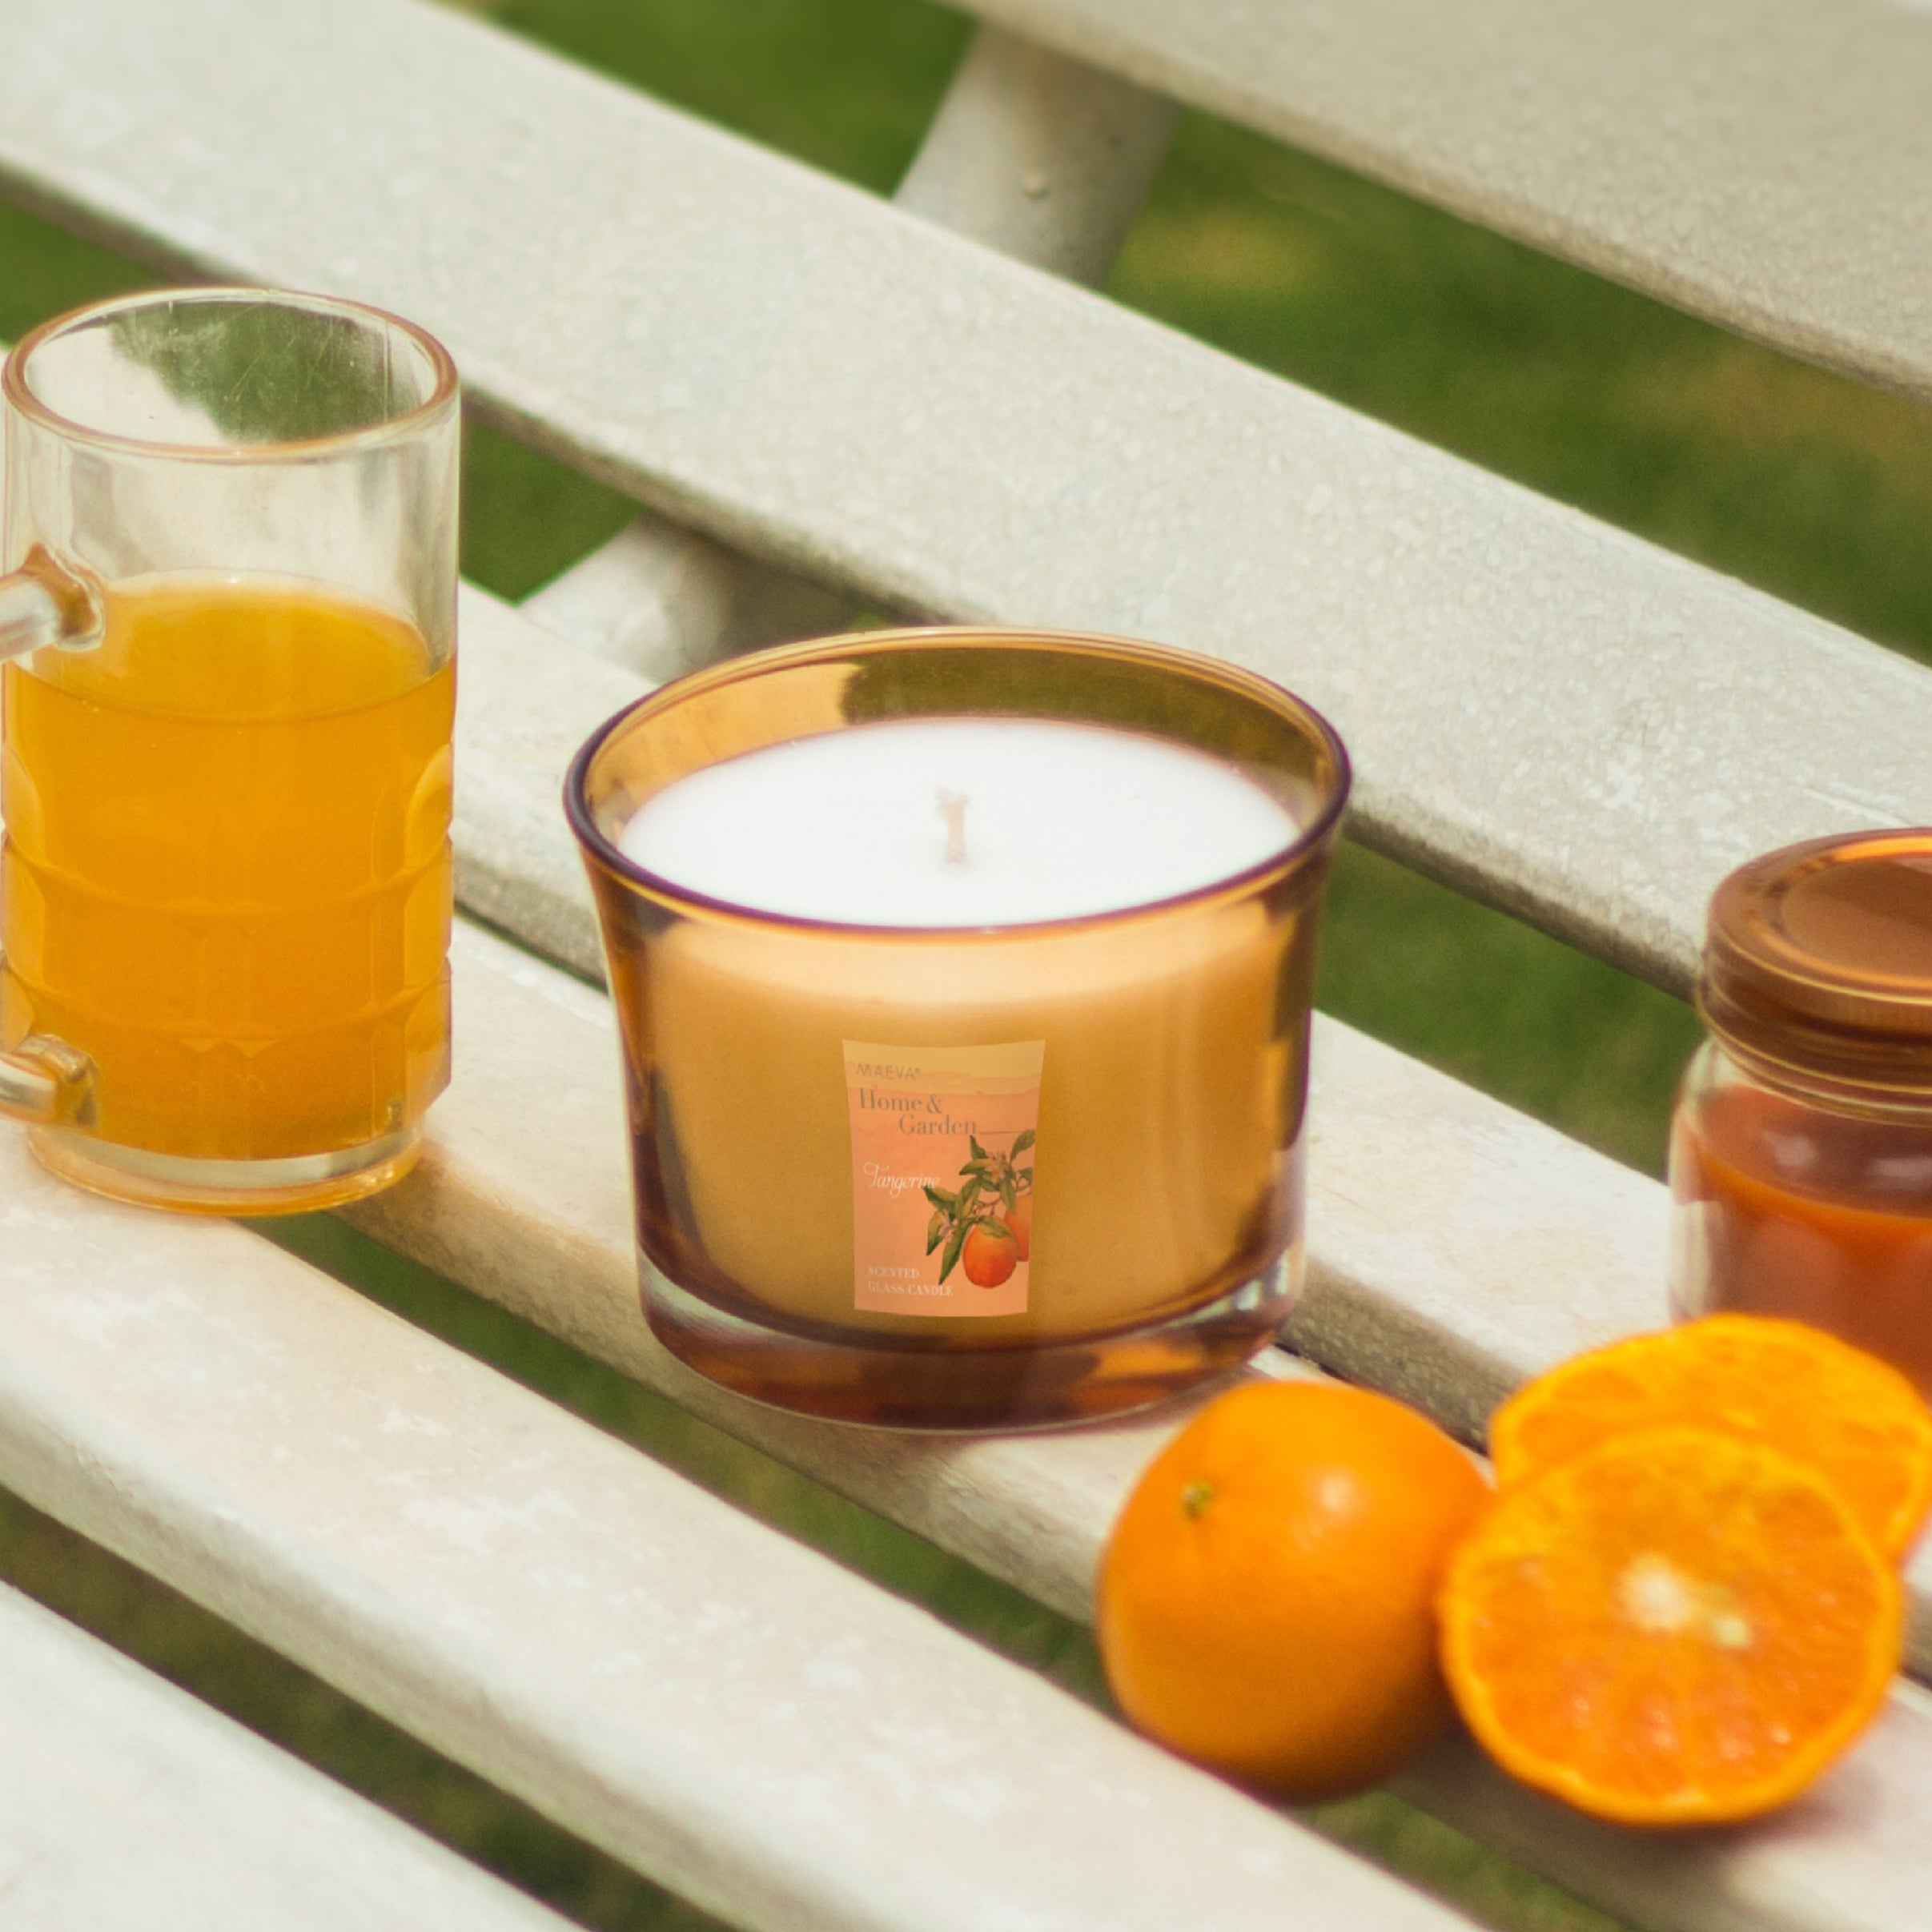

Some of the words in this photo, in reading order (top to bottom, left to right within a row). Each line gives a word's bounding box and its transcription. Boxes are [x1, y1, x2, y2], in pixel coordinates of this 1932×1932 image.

[859, 1087, 922, 1111] Home
[926, 1094, 942, 1114] &
[898, 1114, 977, 1135] Garden
[863, 1161, 941, 1199] Tangerine
[867, 1267, 920, 1279] SCENTED
[867, 1281, 905, 1294] GLASS
[907, 1283, 954, 1296] CANDLE
